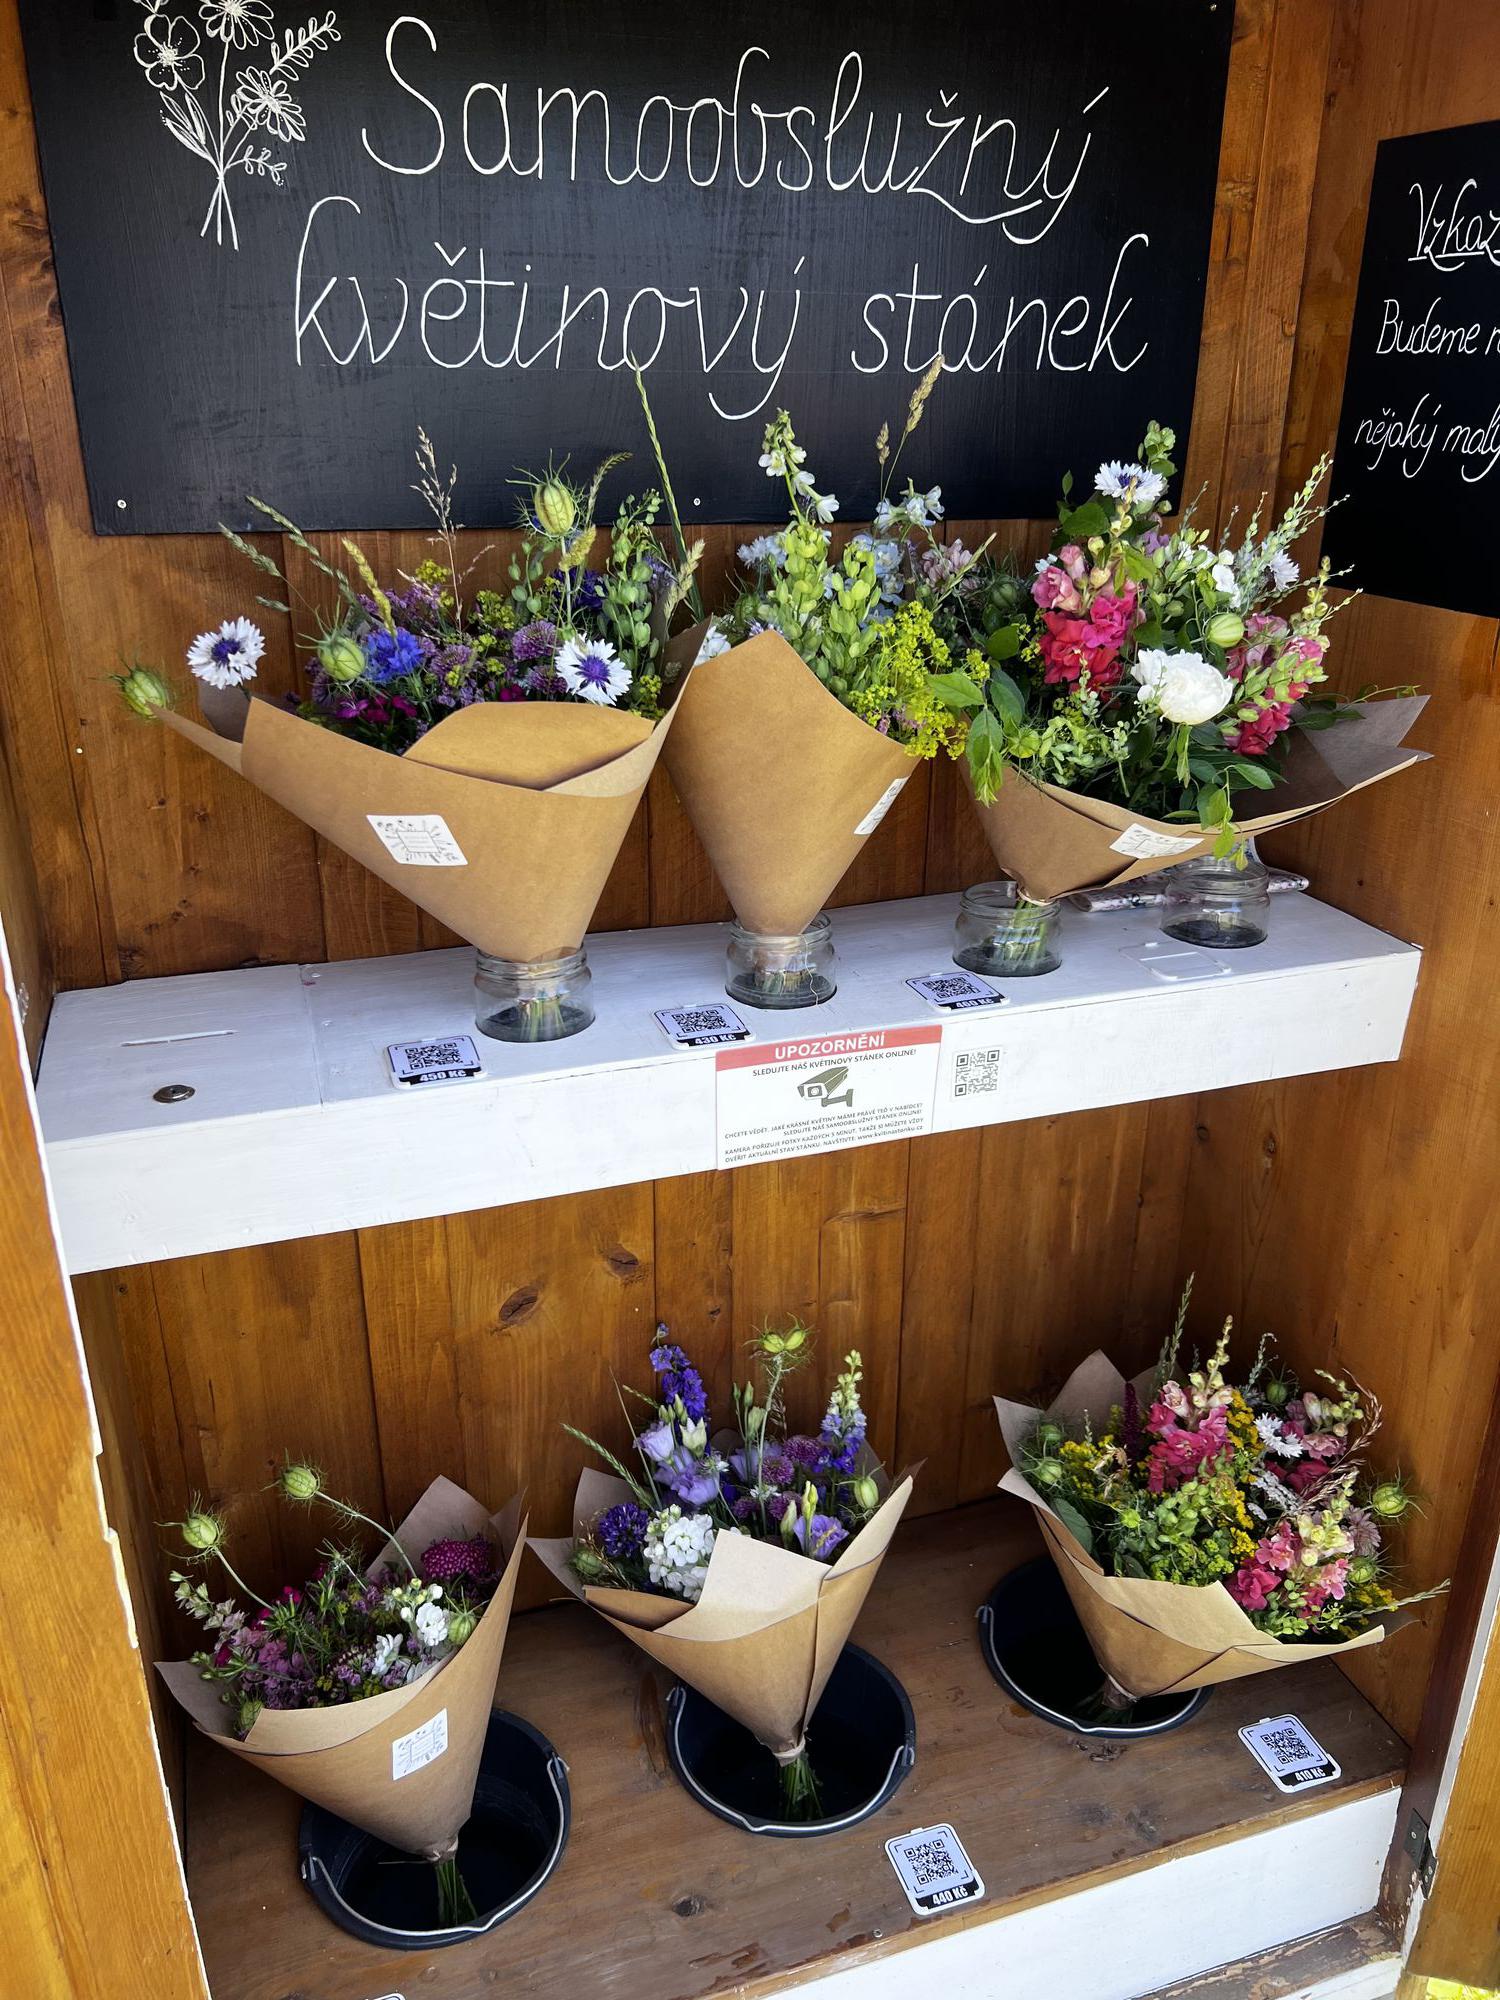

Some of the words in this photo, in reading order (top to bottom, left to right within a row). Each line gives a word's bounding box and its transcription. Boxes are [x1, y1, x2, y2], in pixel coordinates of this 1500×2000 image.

[361, 16, 1109, 245] Samoobslužný
[294, 196, 805, 420] květinový
[851, 233, 1149, 374] stánek
[1376, 297, 1480, 355] Budeme
[1354, 393, 1441, 479] nějaký
[695, 1036, 719, 1045] 430
[775, 1032, 885, 1060] UPOZORNĚNÍ
[752, 1065, 789, 1077] SLEDUJTE
[791, 1062, 808, 1071] NÁŠ
[809, 1056, 853, 1069] KVĚTINOVÝ
[854, 1052, 884, 1062] STÁNEK
[886, 1049, 917, 1058] ONLINE!
[420, 1071, 447, 1082] 450
[725, 1131, 747, 1139] CHCETE
[783, 1127, 811, 1136] SLEDUJTE
[1295, 1769, 1313, 1782] 410
[932, 1890, 953, 1905] 440
[952, 1885, 968, 1899] Kč
